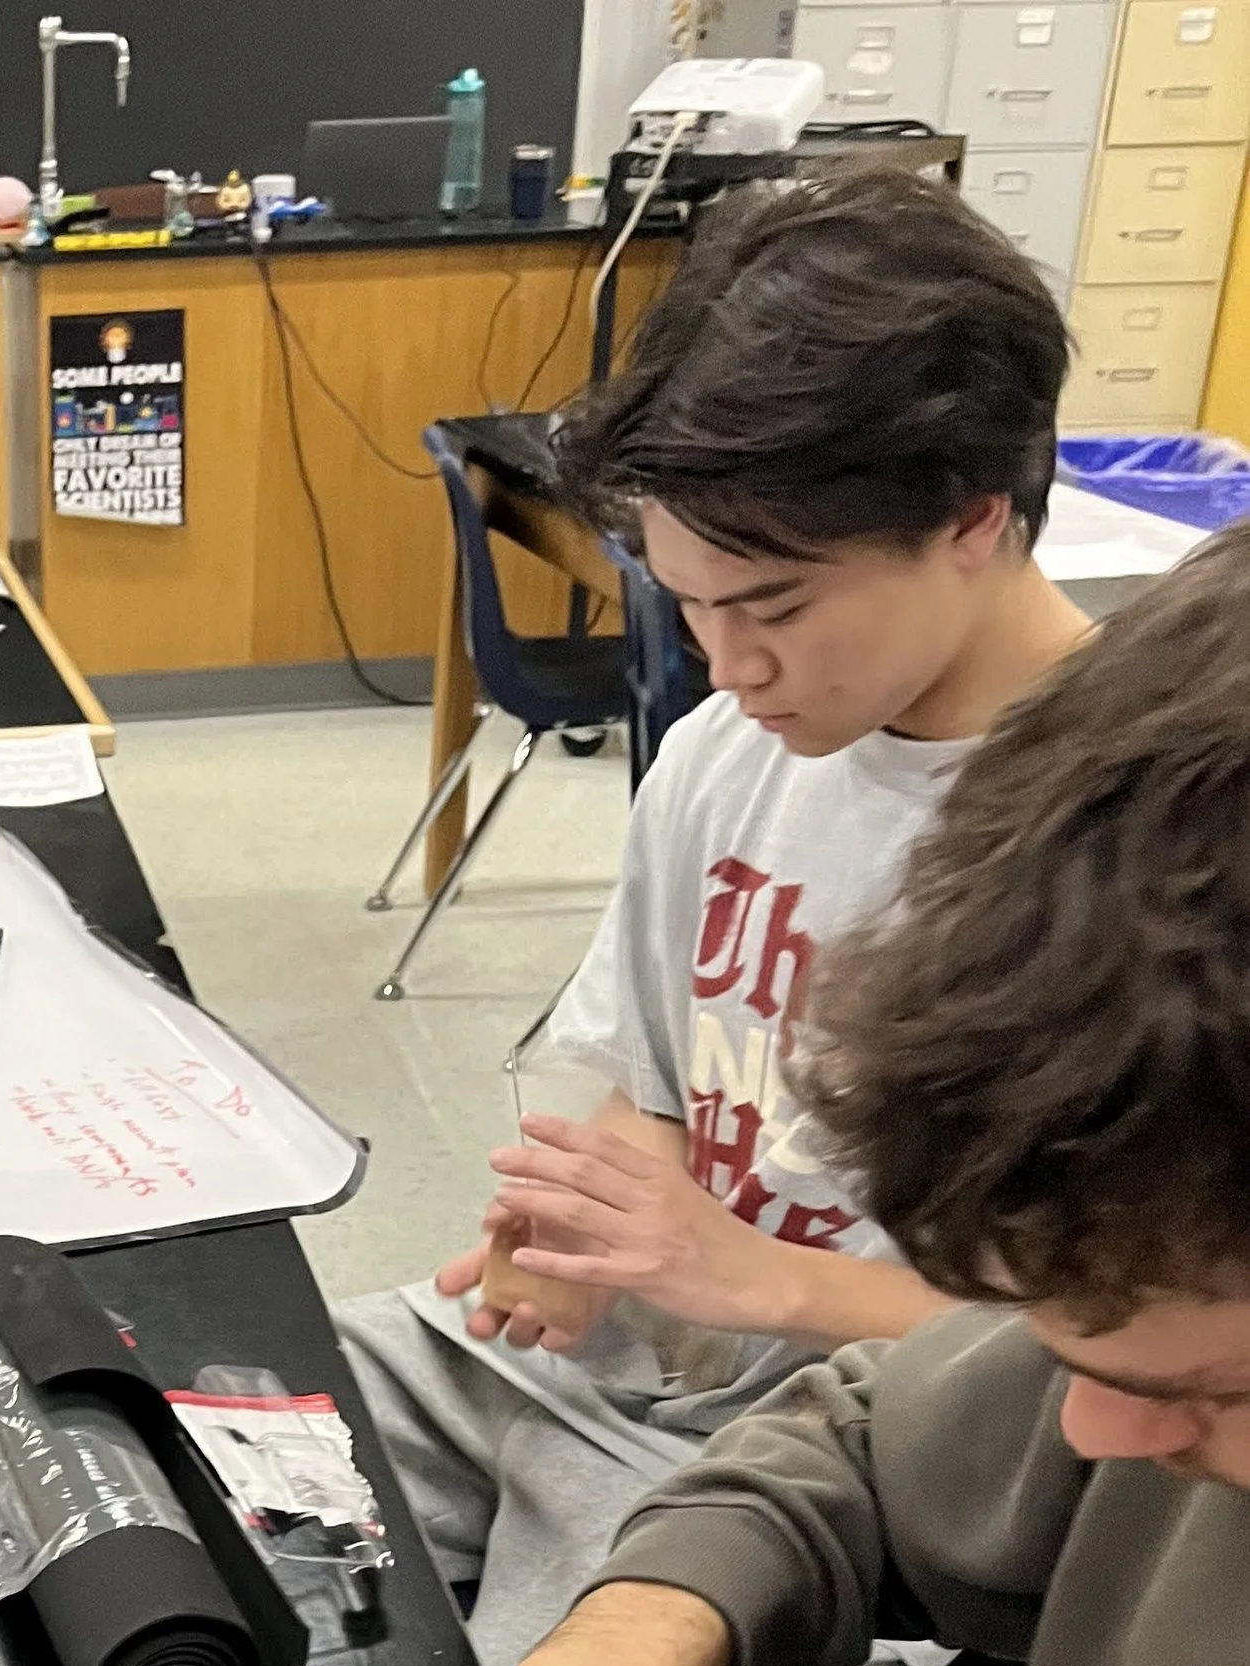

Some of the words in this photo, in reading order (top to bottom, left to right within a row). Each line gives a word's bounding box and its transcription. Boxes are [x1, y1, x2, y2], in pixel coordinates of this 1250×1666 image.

[52, 365, 108, 389] SOME
[54, 465, 181, 491] FAVORITE
[56, 487, 181, 510] SCIENTISTS
